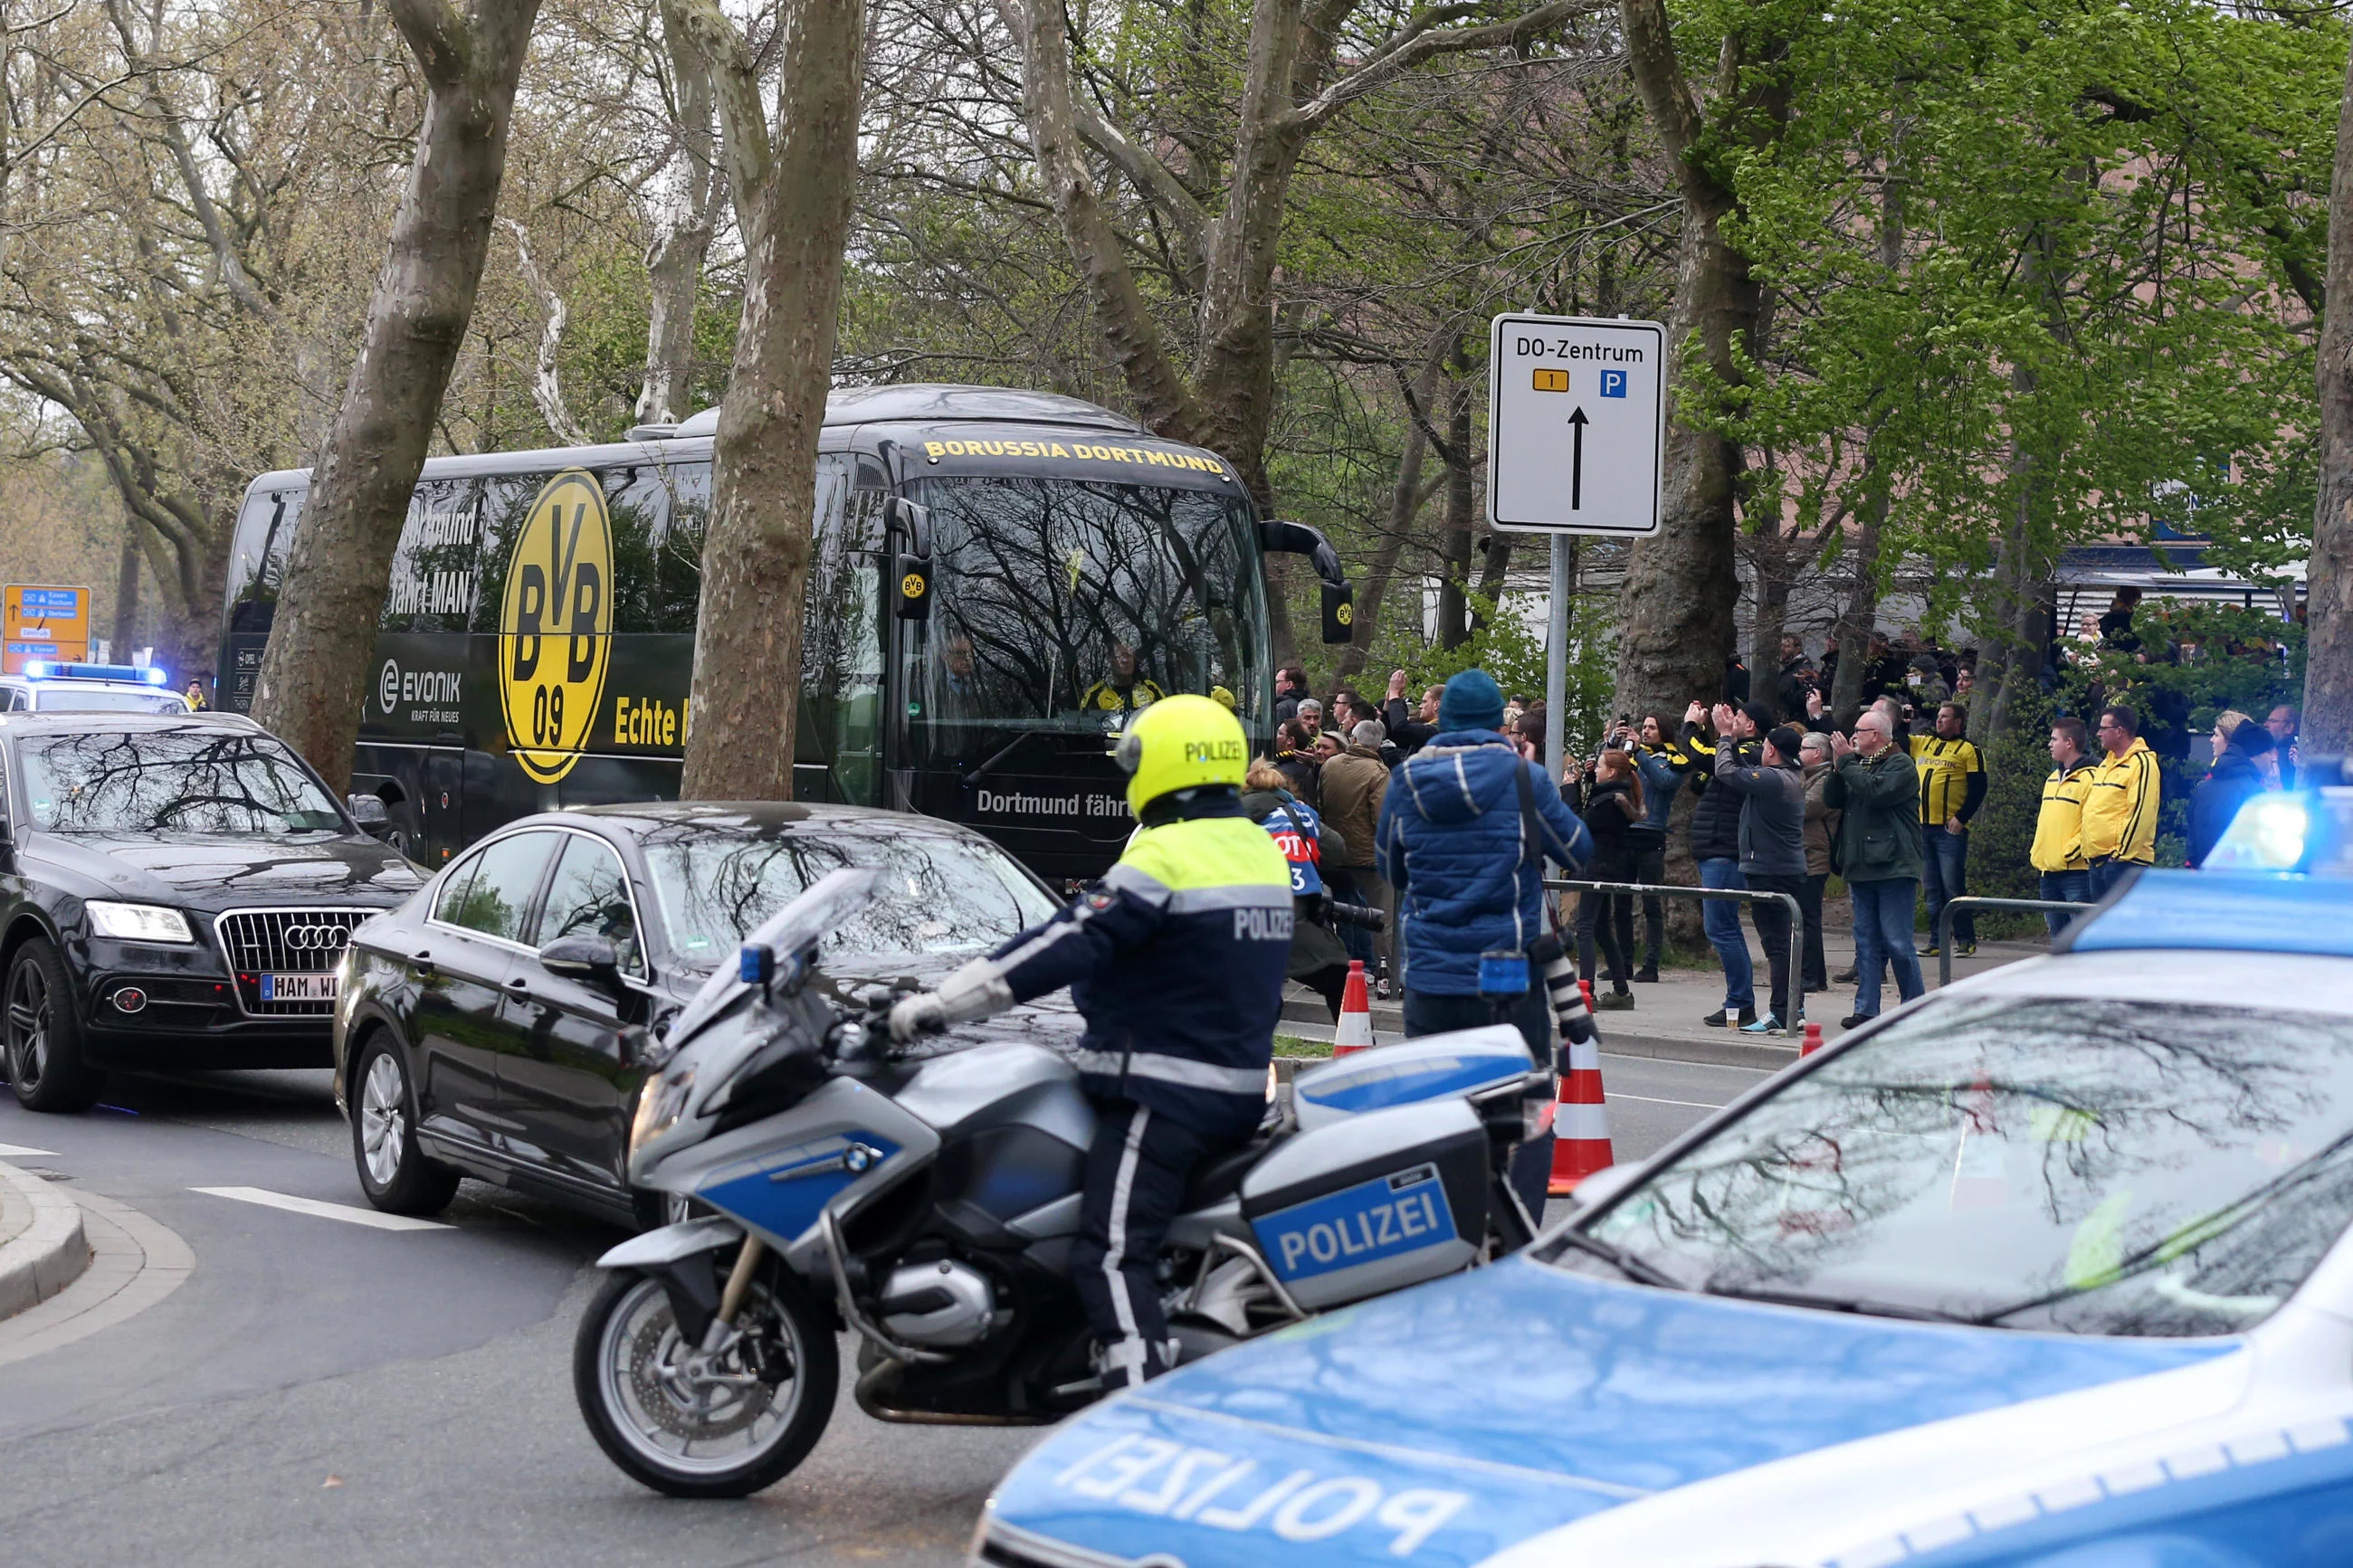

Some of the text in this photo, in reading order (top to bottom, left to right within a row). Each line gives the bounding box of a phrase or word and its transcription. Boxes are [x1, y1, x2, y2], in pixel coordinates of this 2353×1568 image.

[1517, 337, 1643, 363] DO-Zentrum
[1548, 374, 1554, 388] 1
[924, 441, 1224, 475] BORUSSIA DORTMUND
[430, 571, 470, 614] MAN
[513, 503, 601, 683] BVB
[905, 576, 922, 591] BVB
[403, 671, 462, 703] EVONIK
[411, 708, 460, 723] KRAFT FÜR NEUES
[532, 684, 564, 747] 09
[615, 697, 676, 746] Echte
[977, 789, 1081, 816] Dortmund
[274, 977, 309, 997] HAM
[1279, 1192, 1438, 1271] POLIZEI
